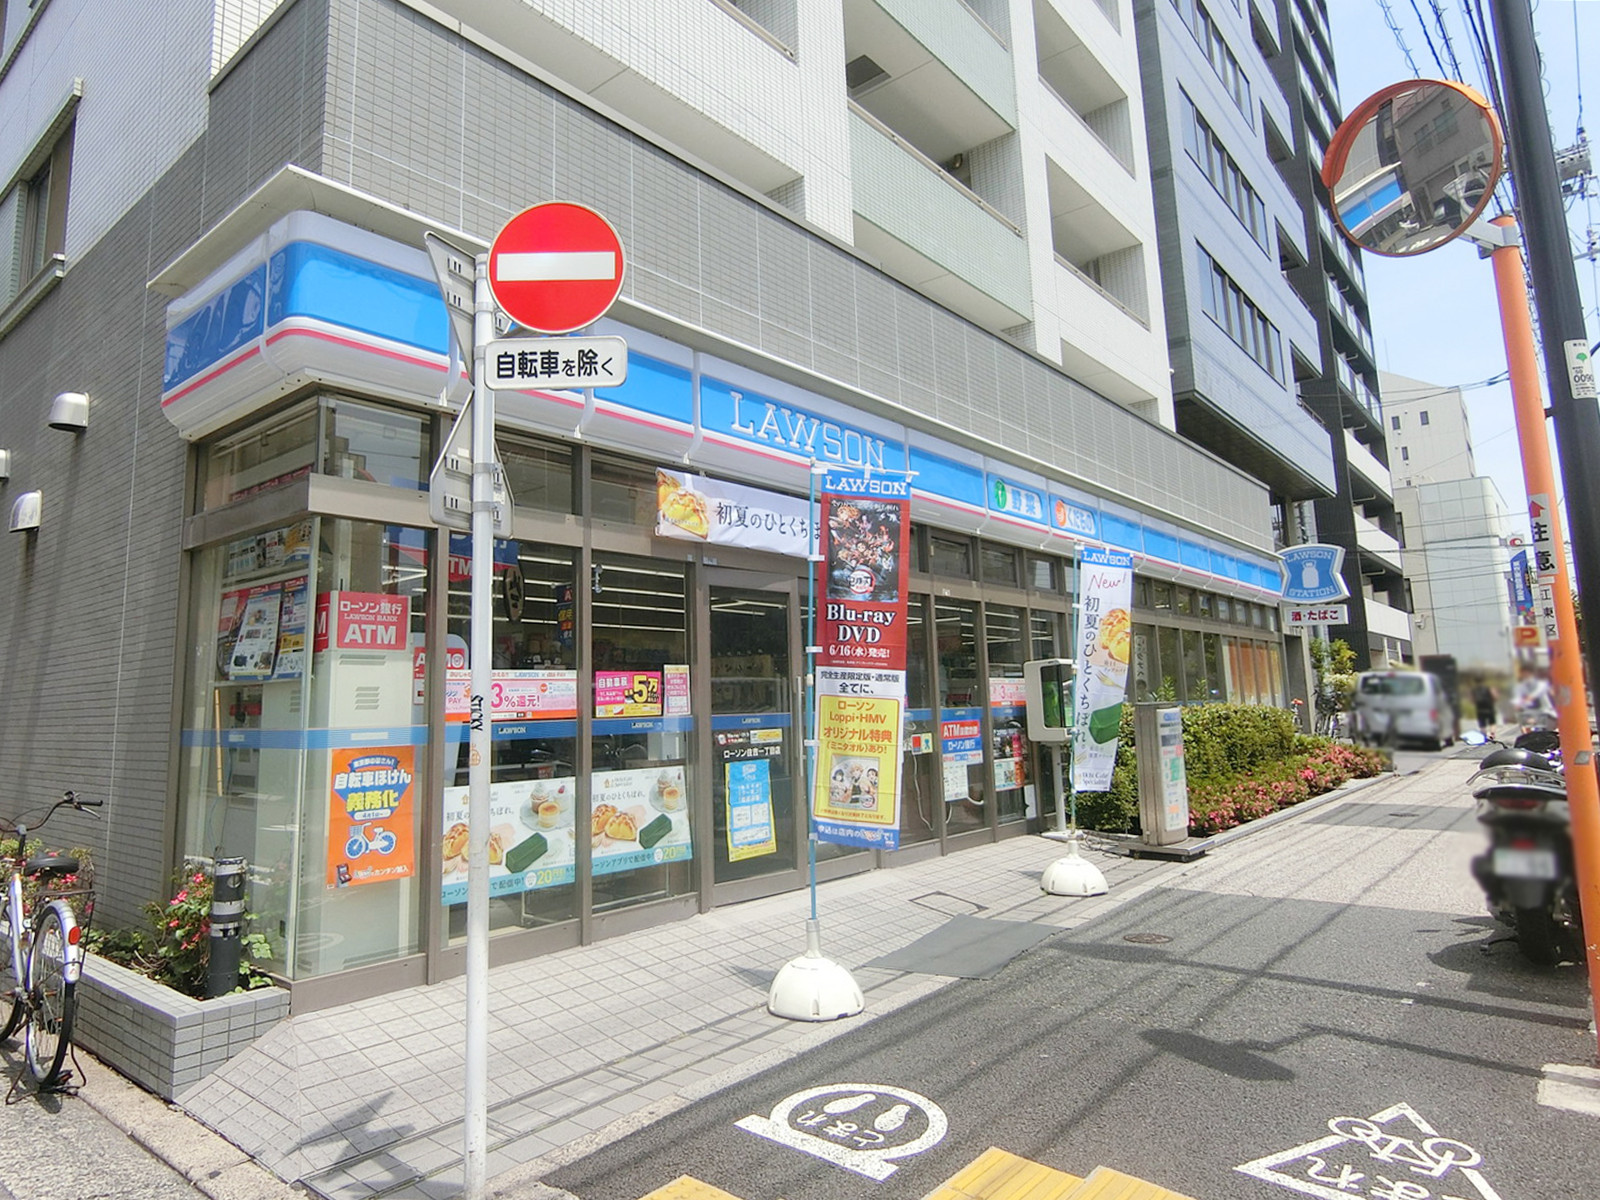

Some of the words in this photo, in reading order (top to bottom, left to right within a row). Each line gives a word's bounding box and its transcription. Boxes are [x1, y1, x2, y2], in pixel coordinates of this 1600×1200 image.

[497, 348, 614, 379] 自転車を除く
[730, 391, 885, 469] LAWSON
[825, 476, 907, 496] LAWSON
[1083, 551, 1131, 566] LAWSON
[1287, 550, 1332, 563] LAWSON
[449, 558, 473, 576] TM
[1088, 572, 1127, 592] New!
[1289, 585, 1336, 598] STATION
[340, 600, 403, 615] ローソン銀行
[827, 604, 896, 627] Blu-ray
[343, 623, 397, 645] ATM
[838, 624, 881, 643] DVD
[837, 700, 875, 711] ローソン
[823, 726, 893, 744] オリジナル特典
[334, 768, 412, 790] 自転車ほけん
[346, 789, 399, 812] 義務化
[591, 852, 654, 869] ーソンアプリで配信中!
[796, 1110, 885, 1146] とまれ
[1307, 1155, 1467, 1200] まれ
